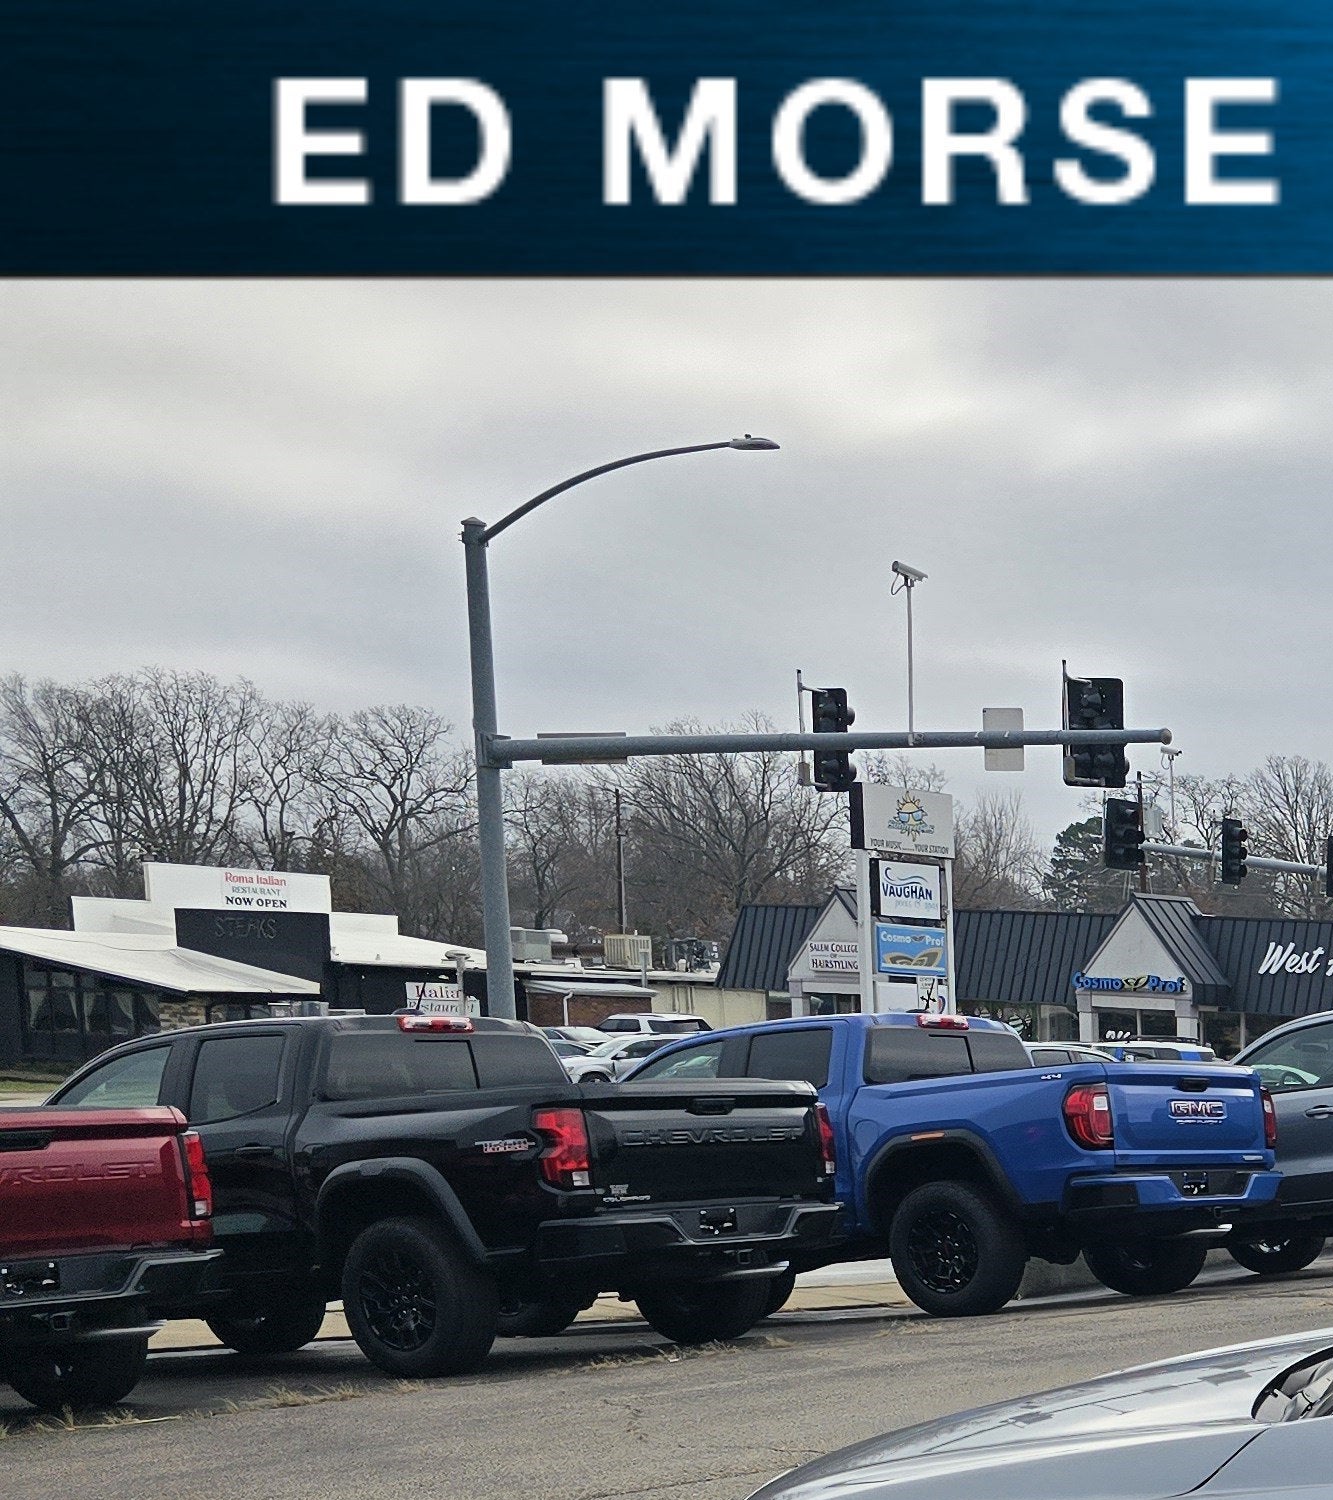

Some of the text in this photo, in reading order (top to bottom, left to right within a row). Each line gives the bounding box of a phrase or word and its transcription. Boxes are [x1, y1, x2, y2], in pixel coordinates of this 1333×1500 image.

[225, 872, 287, 886] Roma Italian
[232, 886, 281, 896] RESTAURANT
[882, 882, 932, 900] VAUGHAN
[225, 896, 287, 908] NOW OPEN
[880, 930, 945, 947] Cosmo Prof
[809, 943, 858, 953] SALEM COLLEGE
[812, 959, 859, 970] HAIRSTYLING
[1258, 941, 1324, 975] West
[1072, 971, 1185, 992] Cosmo Prof
[1170, 1101, 1224, 1117] GMC
[621, 1127, 802, 1147] CHEVROLET
